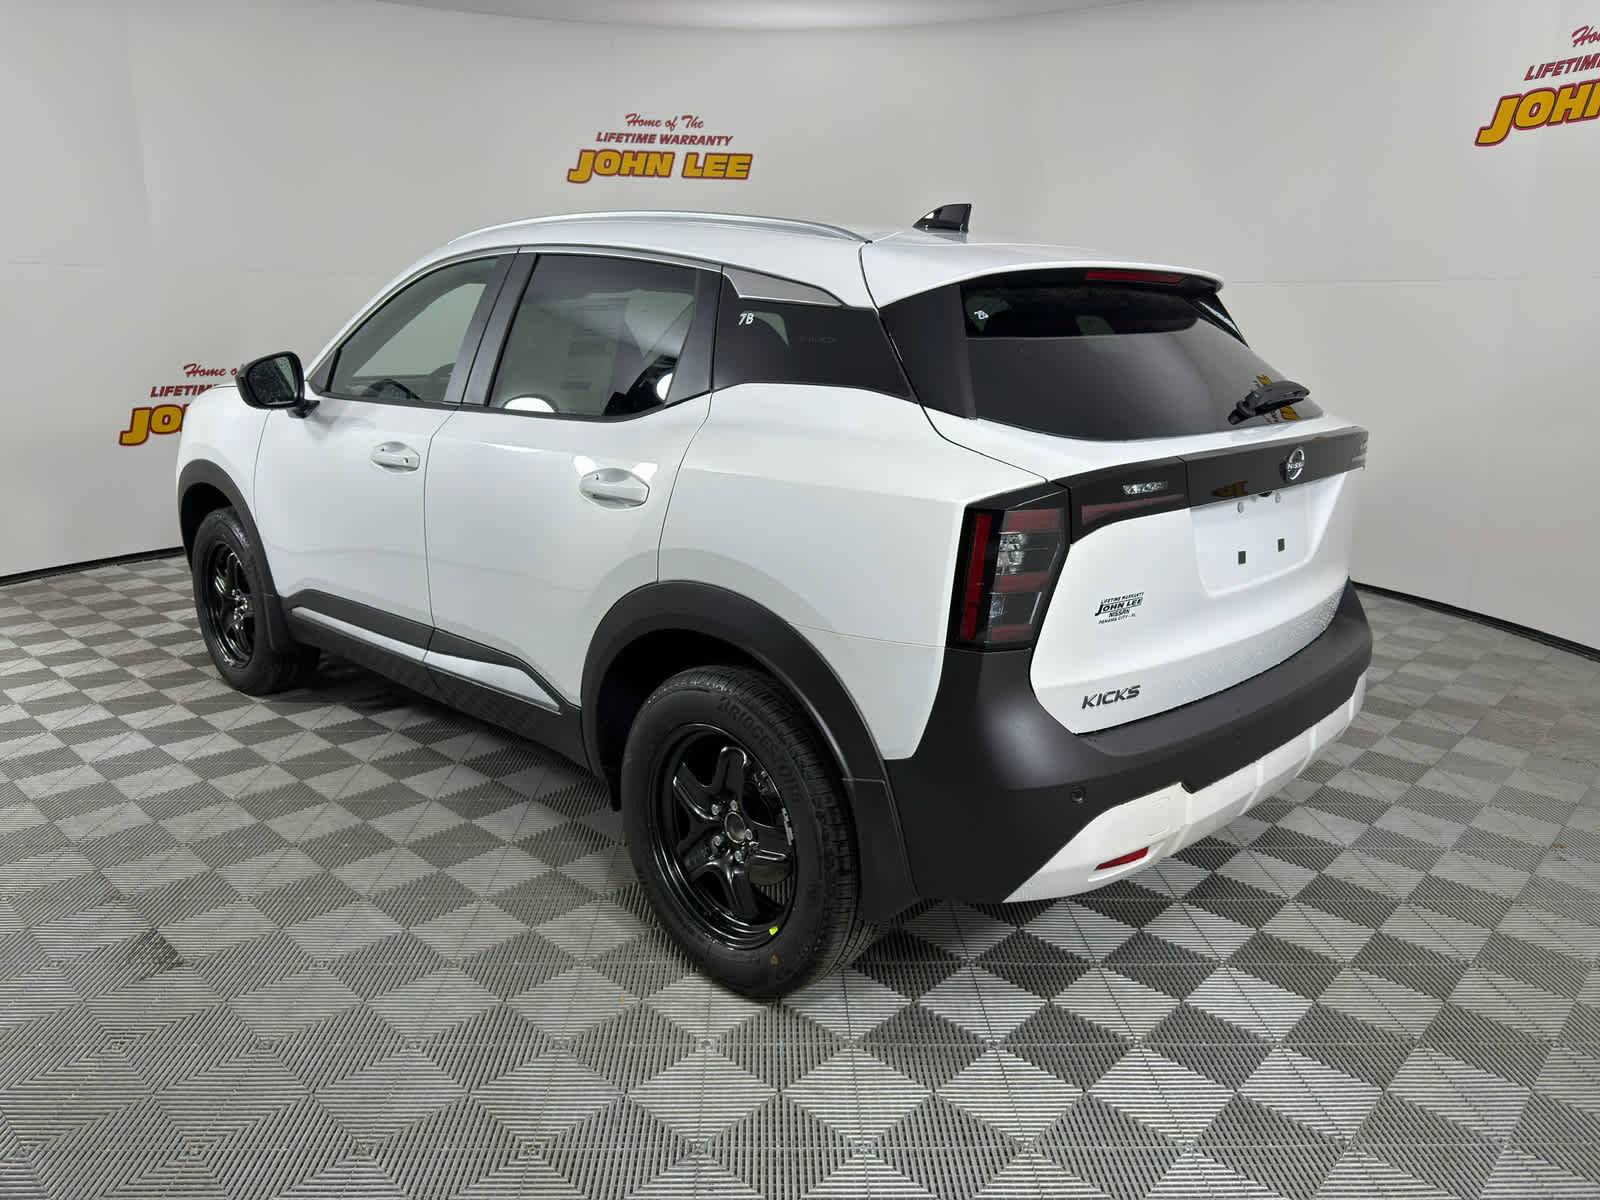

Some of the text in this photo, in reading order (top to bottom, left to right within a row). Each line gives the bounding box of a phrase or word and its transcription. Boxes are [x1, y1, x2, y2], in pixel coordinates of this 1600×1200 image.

[1571, 25, 1600, 48] Ho
[1524, 53, 1600, 81] LIFETIM
[625, 113, 704, 131] Home of The
[596, 132, 733, 146] LIFETIME WARRANTY
[567, 149, 753, 183] JOHN LEE
[183, 363, 226, 378] Home
[151, 384, 220, 398] LIFETIM
[119, 404, 190, 446] JO
[1094, 598, 1142, 616] JOHN LEE
[1081, 684, 1141, 709] KICKS
